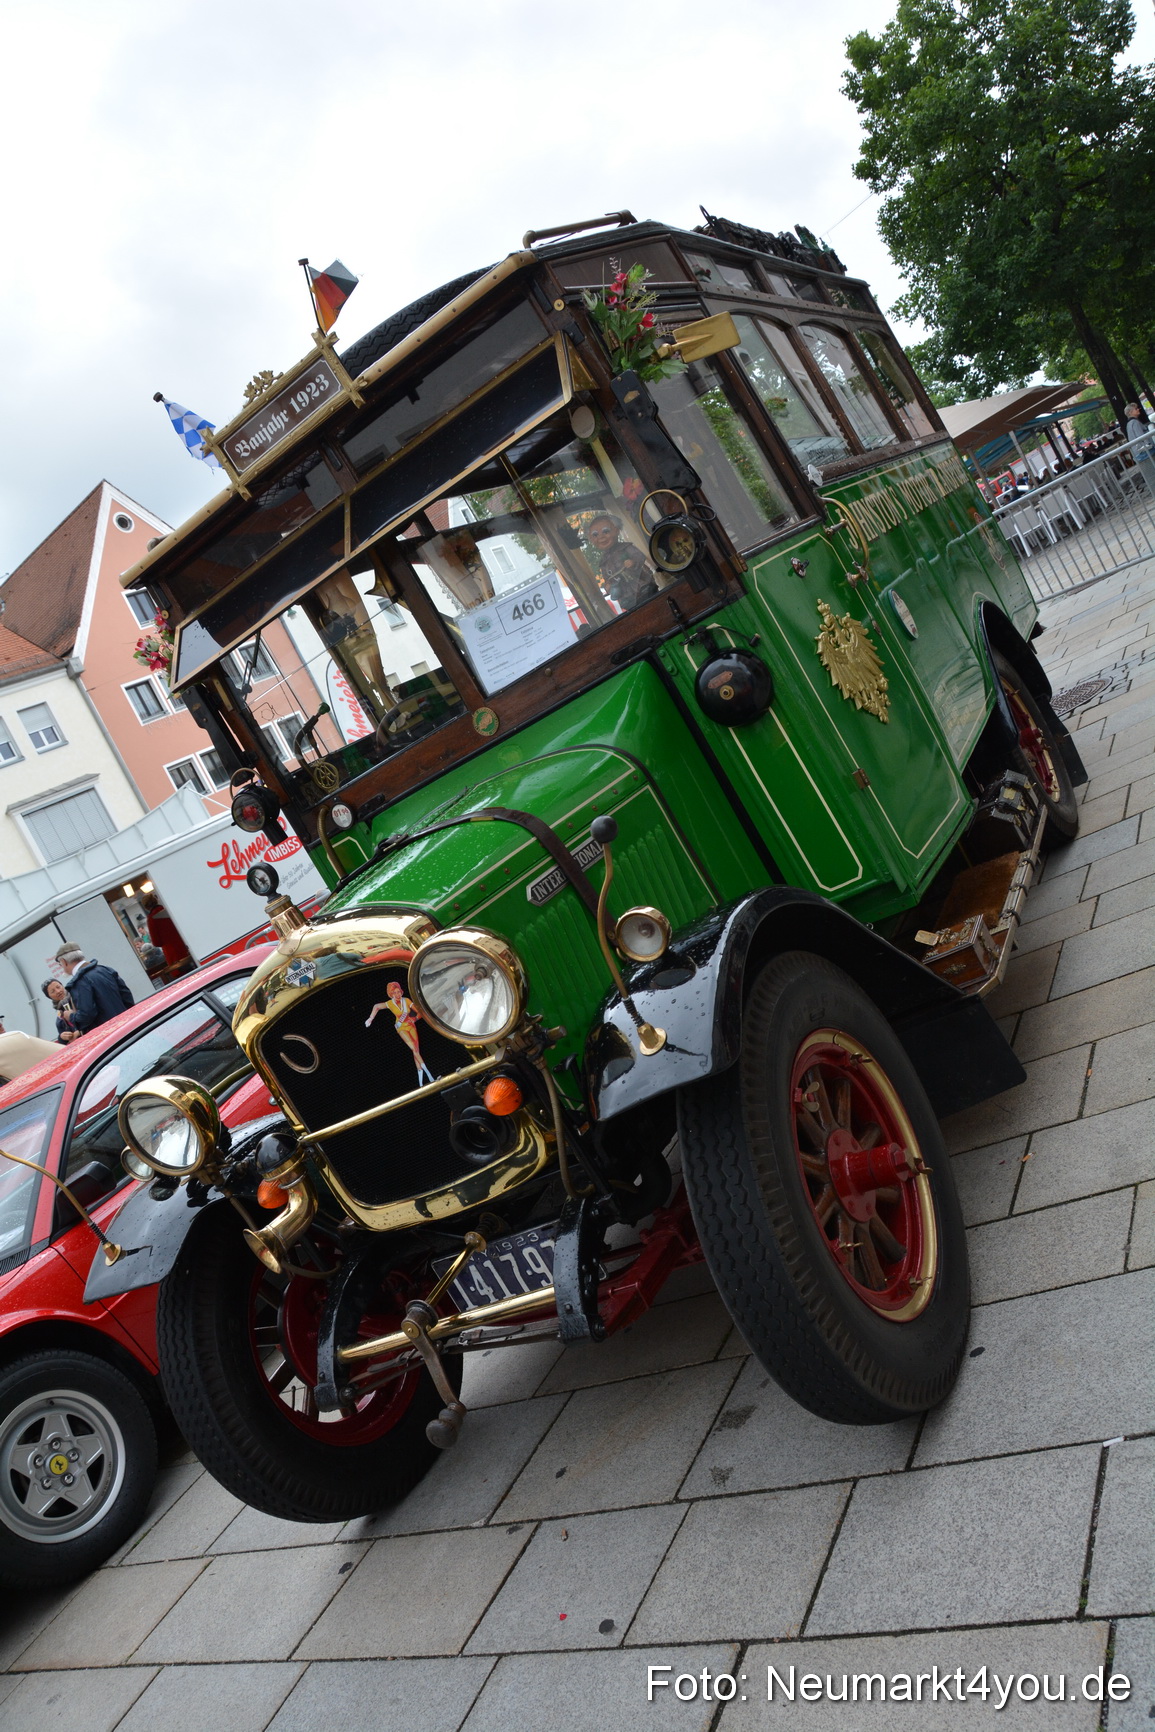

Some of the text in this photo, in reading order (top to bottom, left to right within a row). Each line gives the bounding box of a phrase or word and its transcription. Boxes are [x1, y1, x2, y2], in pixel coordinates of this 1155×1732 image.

[234, 373, 330, 458] Baujahr 1923
[835, 484, 908, 550] JHNSTON'S
[897, 472, 939, 516] MOTOR
[511, 593, 546, 621] 466
[267, 837, 302, 861] IMBISS
[495, 1231, 540, 1253] 1923
